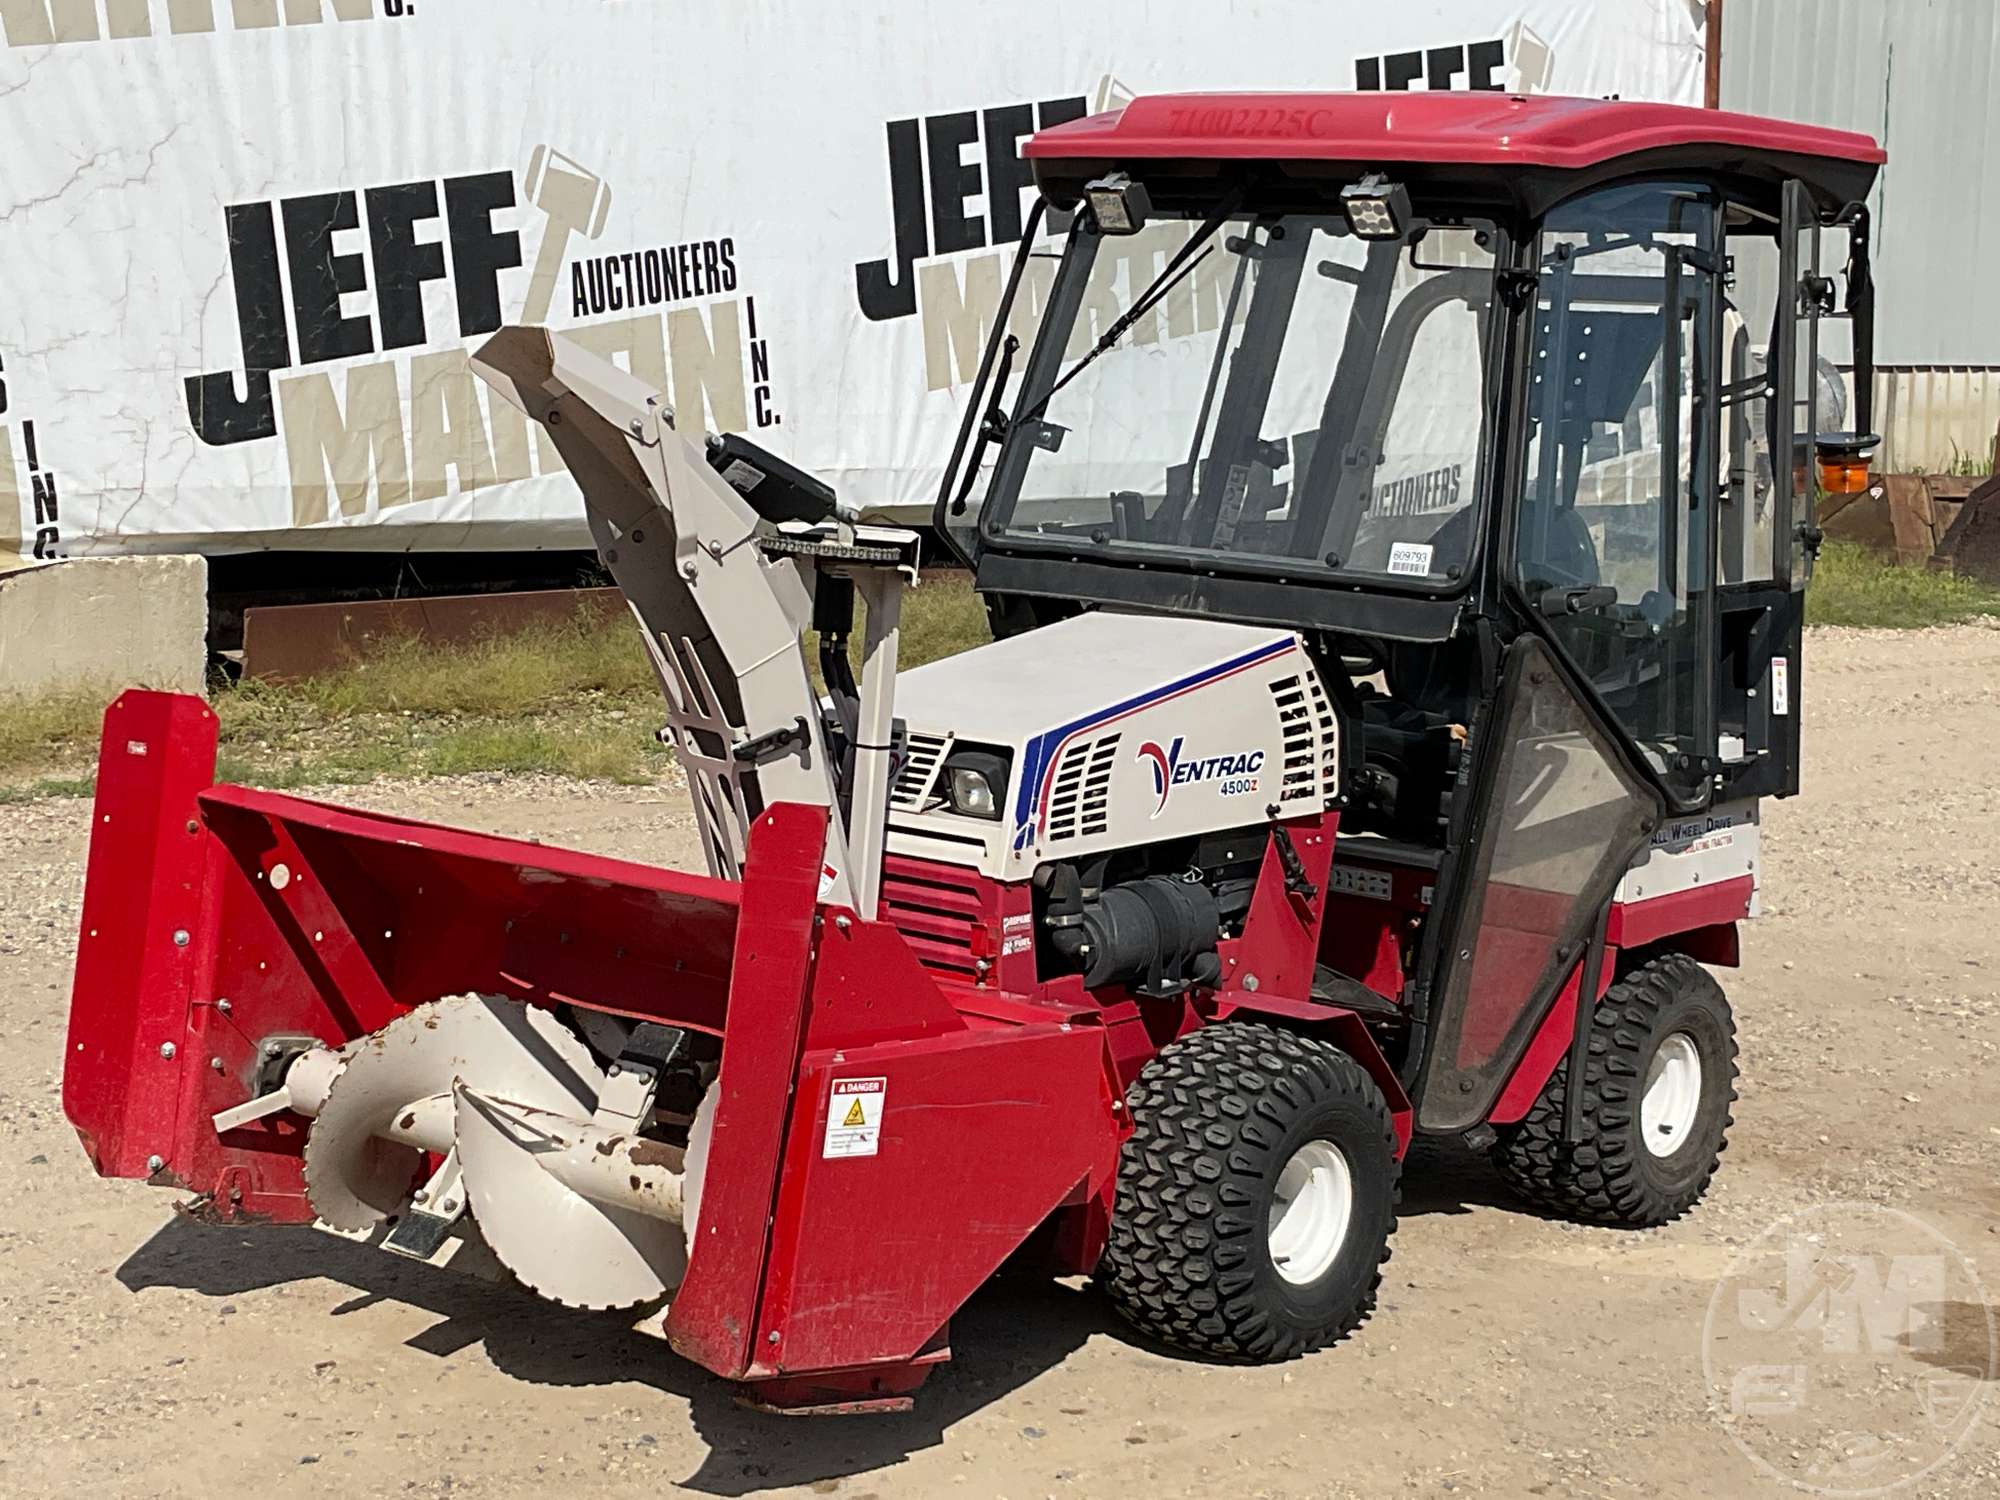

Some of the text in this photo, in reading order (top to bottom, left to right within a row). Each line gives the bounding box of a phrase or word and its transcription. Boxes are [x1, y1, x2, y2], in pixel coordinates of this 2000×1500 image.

[571, 237, 738, 318] AUCTIONEERS
[184, 170, 522, 446] JEFF
[746, 296, 781, 428] INC.
[1369, 464, 1461, 517] UCTIONEERS
[1220, 780, 1258, 795] 4500Z
[1672, 823, 1703, 841] WHEEL
[1706, 817, 1732, 832] DRIVE
[847, 1082, 880, 1093] DANGER
